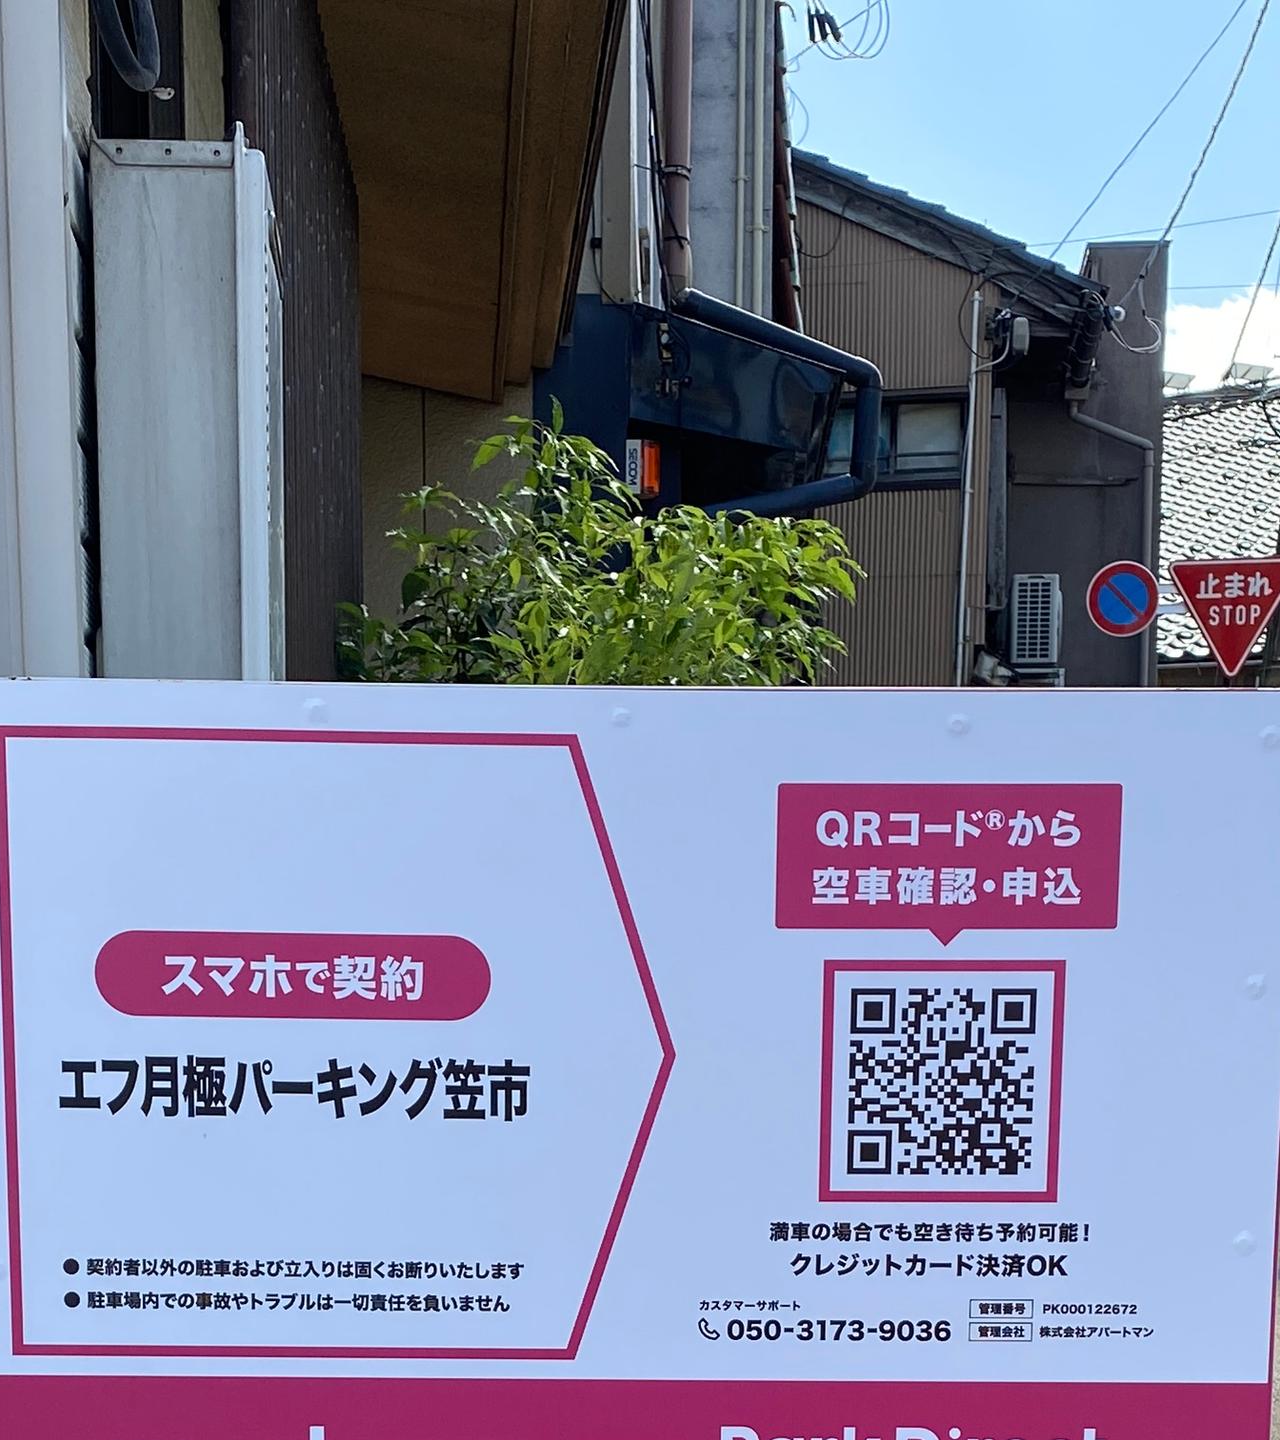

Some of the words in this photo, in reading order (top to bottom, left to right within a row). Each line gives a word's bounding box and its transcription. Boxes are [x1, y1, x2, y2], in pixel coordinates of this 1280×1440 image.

[628, 447, 638, 486] SECOM
[1196, 571, 1273, 599] 止まれ
[1209, 604, 1261, 626] STOP
[811, 866, 1082, 906] 空車確認・申込
[161, 953, 424, 1001] スマホで契約
[58, 1054, 531, 1122] エフ月極パーキング笠市
[86, 1257, 525, 1280] 契約者以外の駐車および立入りは固くお断りいたします
[789, 1252, 1068, 1278] クレジットカード決済OK
[87, 1290, 511, 1313] 駐車場内での事故やトラブルは一切責任を負いません
[699, 1299, 801, 1312] カスタマーサポート
[978, 1303, 1026, 1315] 管理番号
[1042, 1303, 1138, 1315] PK000122672
[726, 1318, 952, 1342] 050-3173-9036
[977, 1325, 1025, 1338] 管理会社
